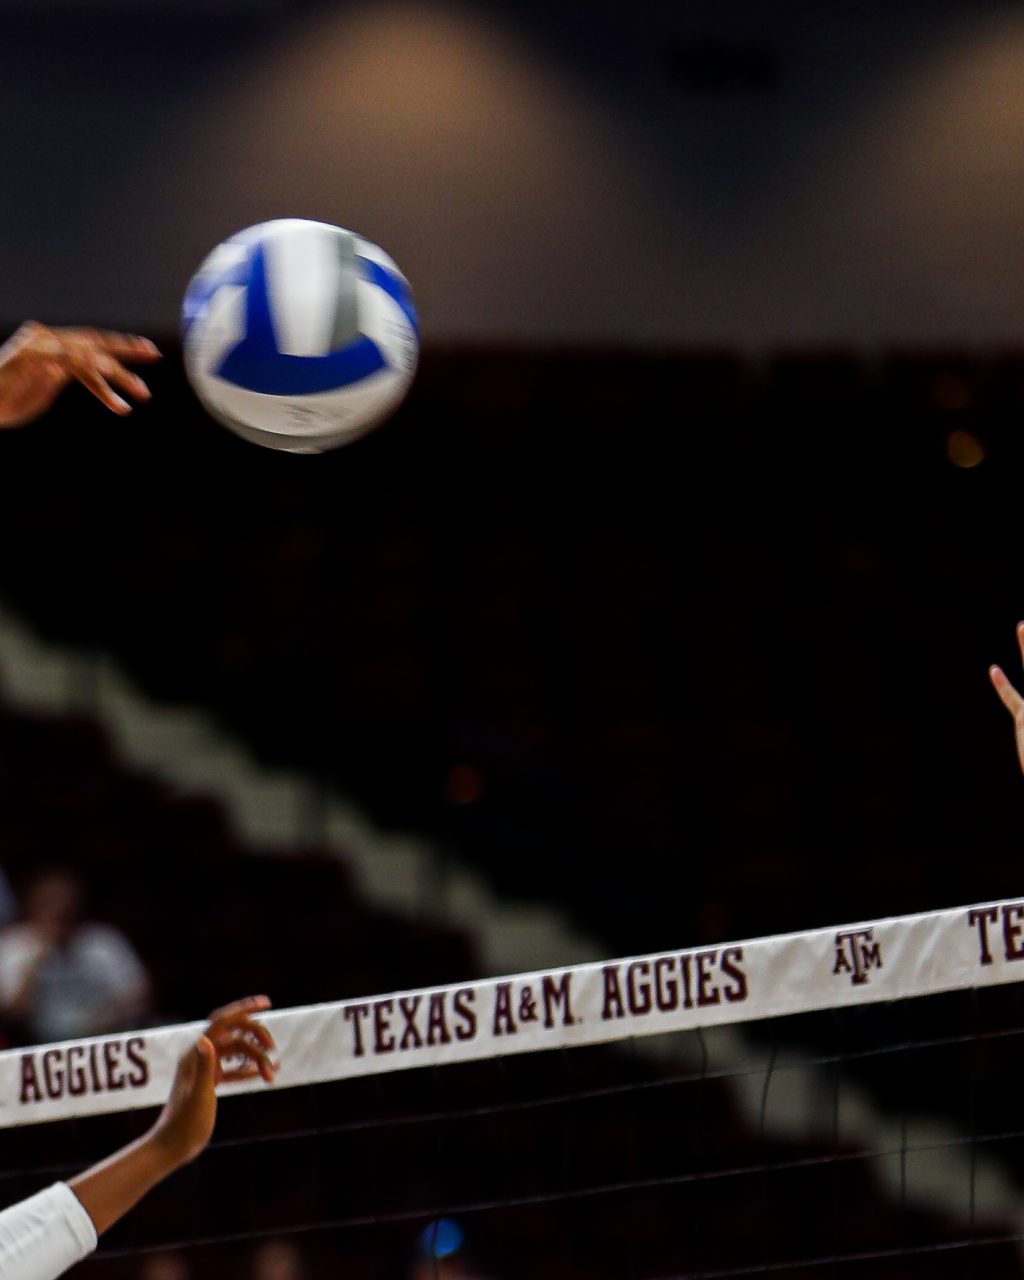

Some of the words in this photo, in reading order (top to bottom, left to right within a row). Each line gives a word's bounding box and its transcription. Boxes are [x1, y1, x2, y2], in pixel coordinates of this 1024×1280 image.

[344, 988, 477, 1058] TEXAS
[492, 972, 575, 1036] A&M
[601, 946, 749, 1021] AGGIES
[19, 1036, 150, 1104] AGGIES
